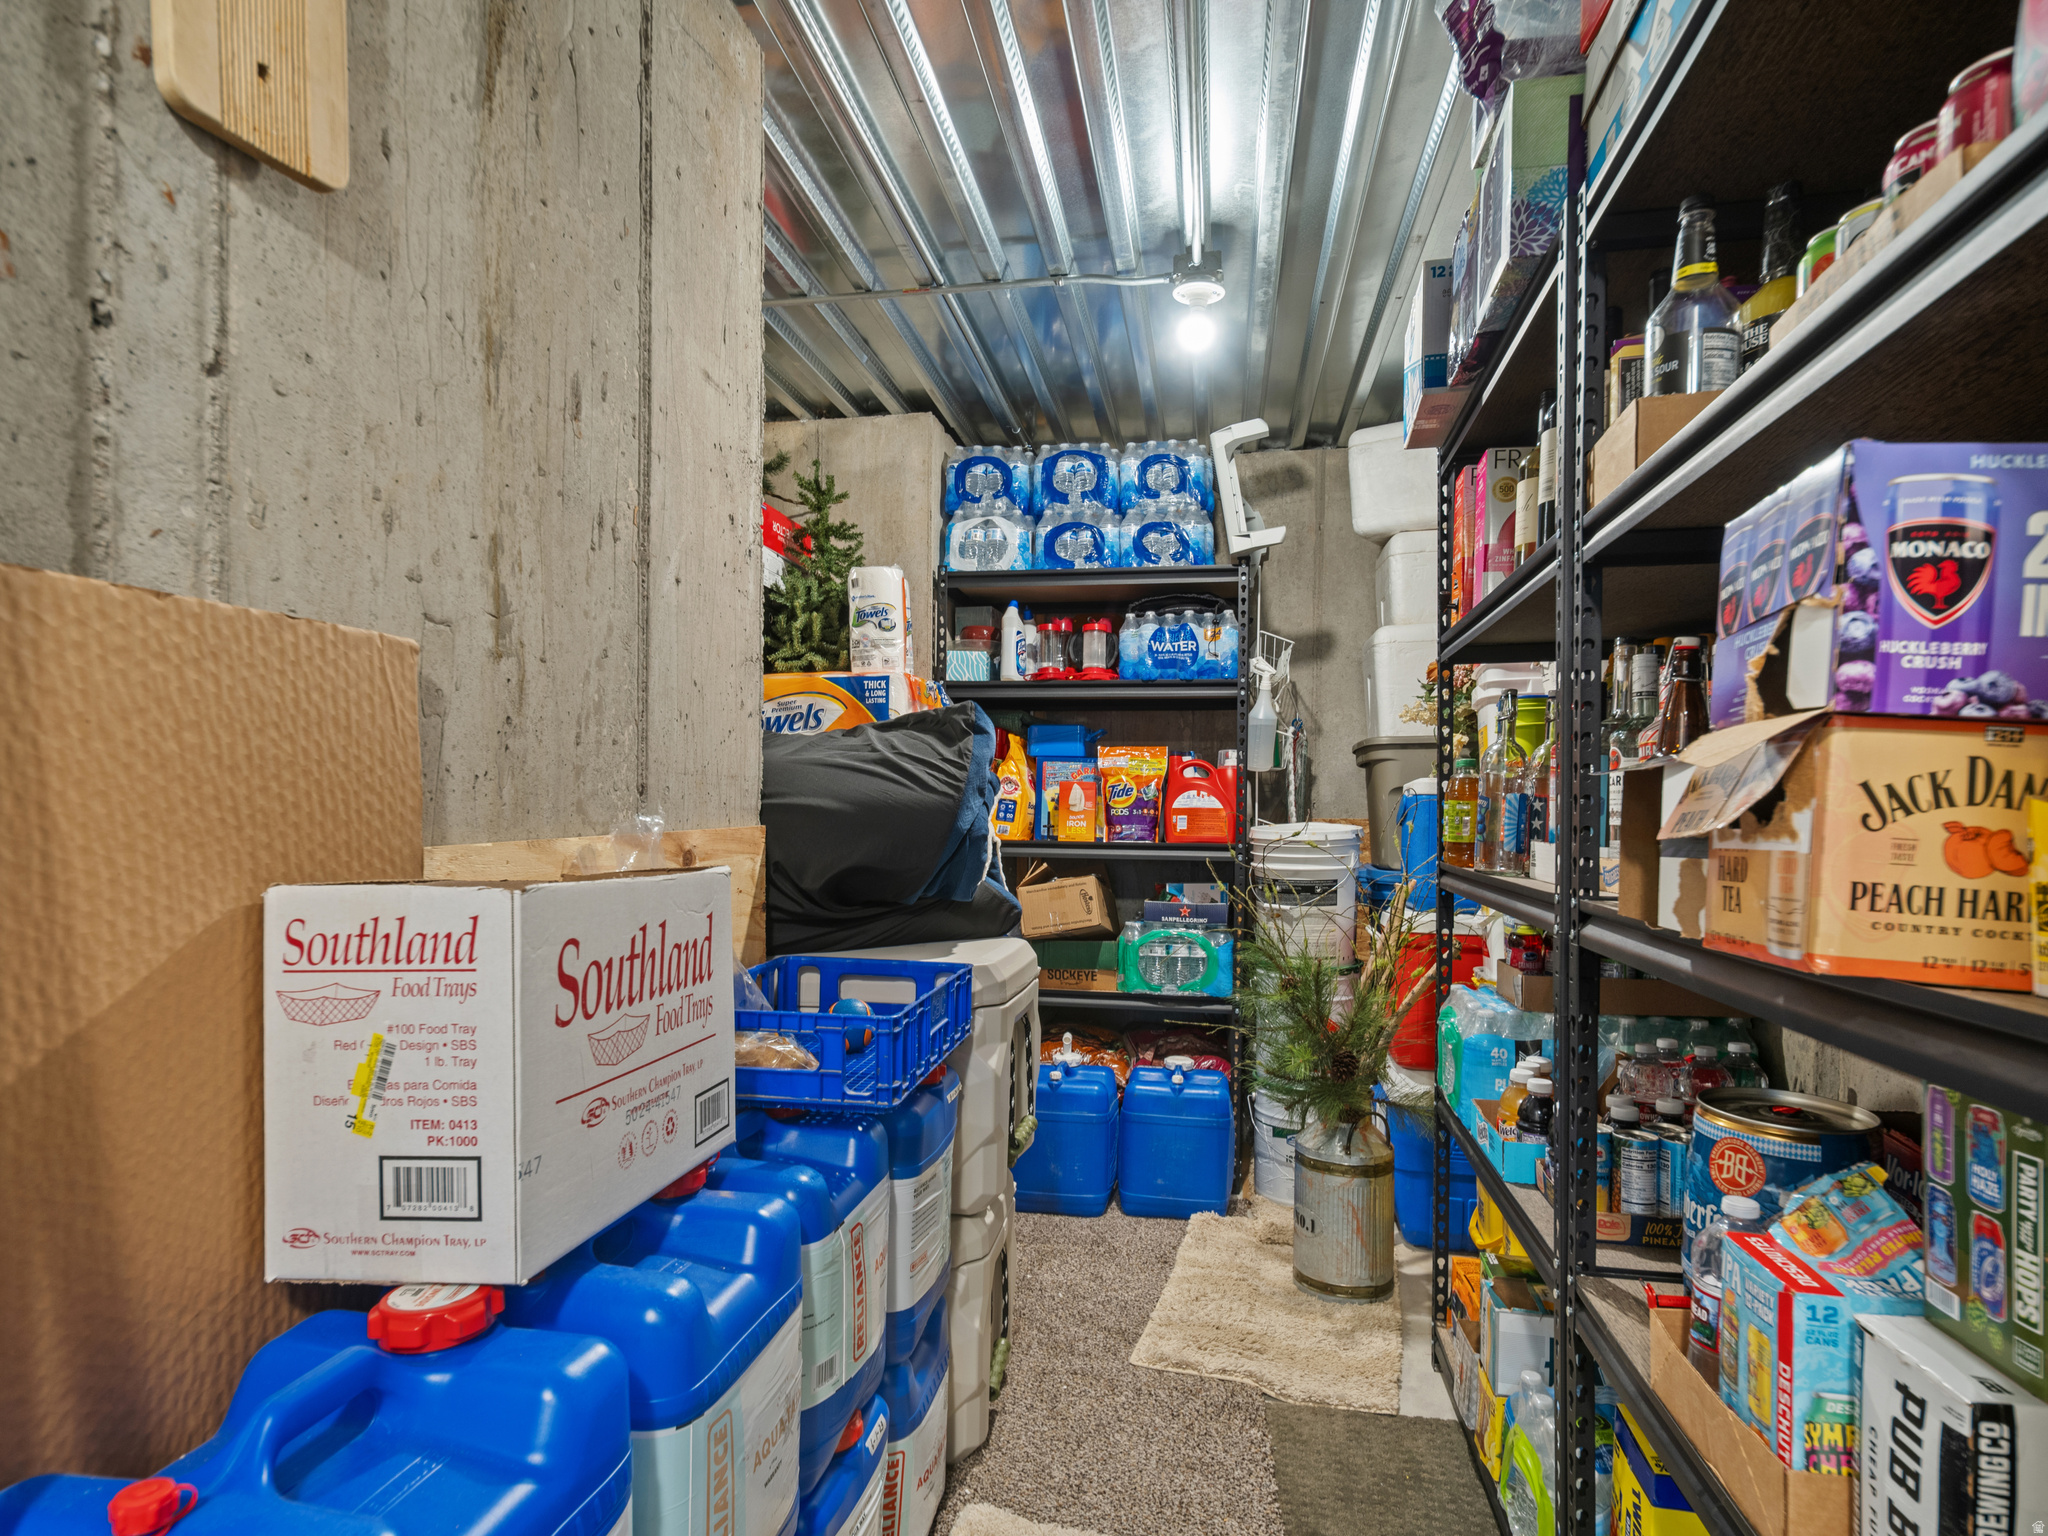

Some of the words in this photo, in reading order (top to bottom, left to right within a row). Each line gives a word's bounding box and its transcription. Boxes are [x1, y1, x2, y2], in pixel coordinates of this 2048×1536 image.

[1430, 265, 1446, 278] 12
[1743, 321, 1769, 338] THE
[1970, 454, 2048, 469] HUCKLE
[1890, 540, 1991, 559] MONACO
[856, 606, 889, 623] Towels
[1150, 640, 1197, 652] WATER
[1879, 640, 1988, 655] HUCKLEBERRY
[1901, 655, 1962, 669] CRUSH
[863, 680, 886, 689] THICK
[870, 689, 886, 697] LONG
[771, 703, 803, 713] Premium
[777, 699, 797, 708] Super
[1107, 783, 1135, 803] Tide
[1857, 768, 1958, 832] JACK
[1110, 808, 1129, 816] PODS
[1717, 855, 1748, 883] HARD
[1722, 885, 1742, 913] TEA
[1848, 881, 1946, 917] PEACH
[1161, 916, 1209, 924] SANPELLEGRINO
[1871, 921, 1962, 936] COUNTRY
[282, 914, 480, 966] Southland
[554, 911, 714, 1029] Southland
[1047, 968, 1098, 982] SOCKEYE
[391, 976, 431, 998] Food
[434, 976, 478, 1004] Trays
[655, 995, 685, 1036] Food
[684, 993, 714, 1029] Trays
[386, 1023, 416, 1036] #100
[418, 1023, 448, 1035] Food
[450, 1023, 478, 1037] Tray
[333, 1040, 357, 1051] Red
[400, 1039, 440, 1054] Design
[450, 1039, 478, 1051] SBS
[1490, 1047, 1508, 1060] 40
[434, 1056, 448, 1067] lb.
[451, 1056, 478, 1069] Tray
[403, 1081, 430, 1091] para
[432, 1079, 477, 1091] Comida
[407, 1096, 441, 1109] Rojos
[451, 1096, 478, 1107] SBS
[410, 1119, 446, 1131] ITEM:
[449, 1119, 478, 1131] 0413
[1499, 1125, 1518, 1136] Welc
[427, 1136, 478, 1147] PK:1000
[2018, 1162, 2038, 1223] PARTY
[1644, 1221, 1673, 1236] 100%
[474, 1238, 487, 1247] LP
[1744, 1236, 1821, 1288] DESCHUTES
[1721, 1250, 1742, 1298] IPA
[853, 1231, 866, 1350] RELIANCE
[2014, 1248, 2041, 1324] HOPS
[1806, 1304, 1840, 1325] 12
[1805, 1335, 1840, 1349] CANS
[1777, 1360, 1791, 1471] DESCHUT
[1889, 1379, 1927, 1504] PUB
[1868, 1425, 1879, 1498] CHEAP
[713, 1421, 729, 1536] IANCE
